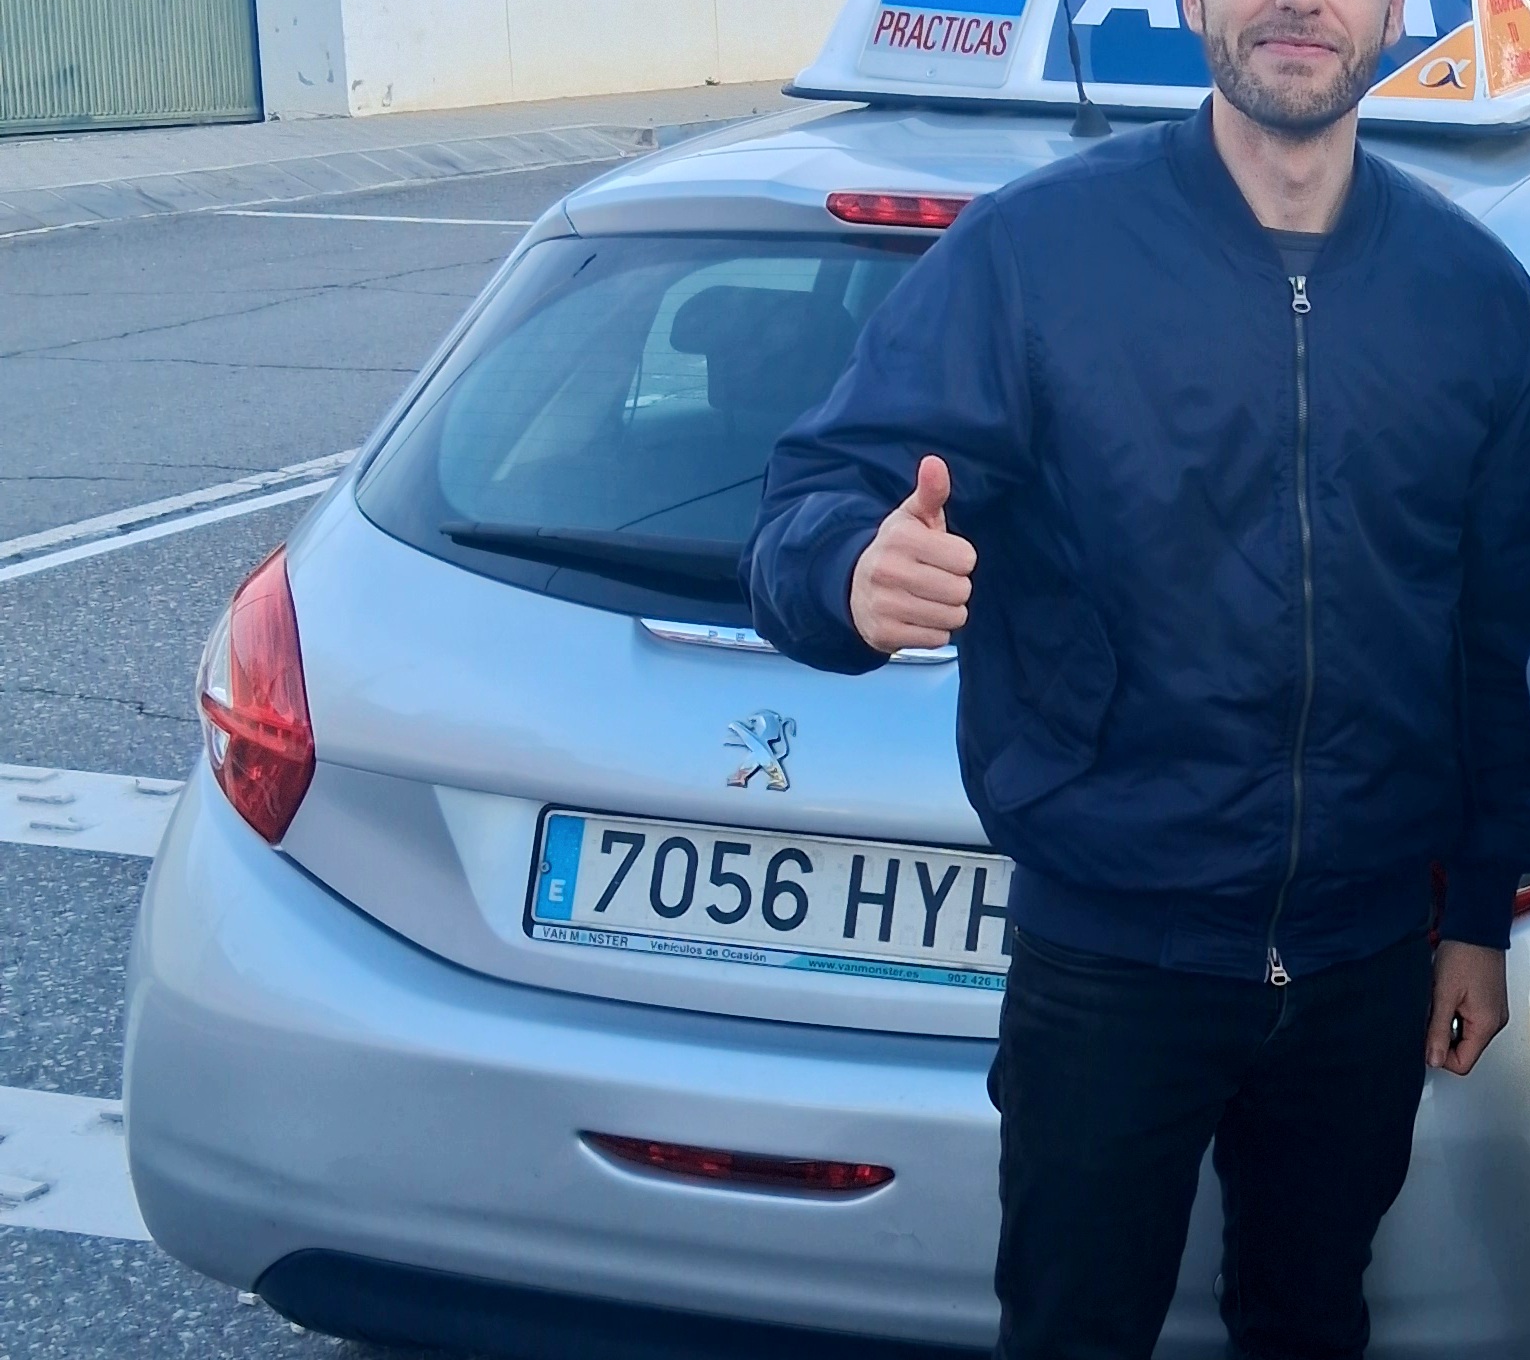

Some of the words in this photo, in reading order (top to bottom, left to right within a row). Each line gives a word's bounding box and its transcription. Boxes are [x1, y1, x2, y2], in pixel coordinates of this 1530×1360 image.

[873, 9, 1013, 56] PRACTICAS
[548, 878, 566, 903] E
[593, 829, 814, 932] 7056
[543, 926, 567, 941] VAN
[570, 930, 629, 947] MNSTER
[650, 940, 703, 955] Vehículos
[706, 947, 719, 957] de
[722, 948, 767, 963] Ocasión
[808, 959, 920, 979] www.vanmonster.es
[948, 973, 967, 984] 902
[971, 975, 991, 986] 426
